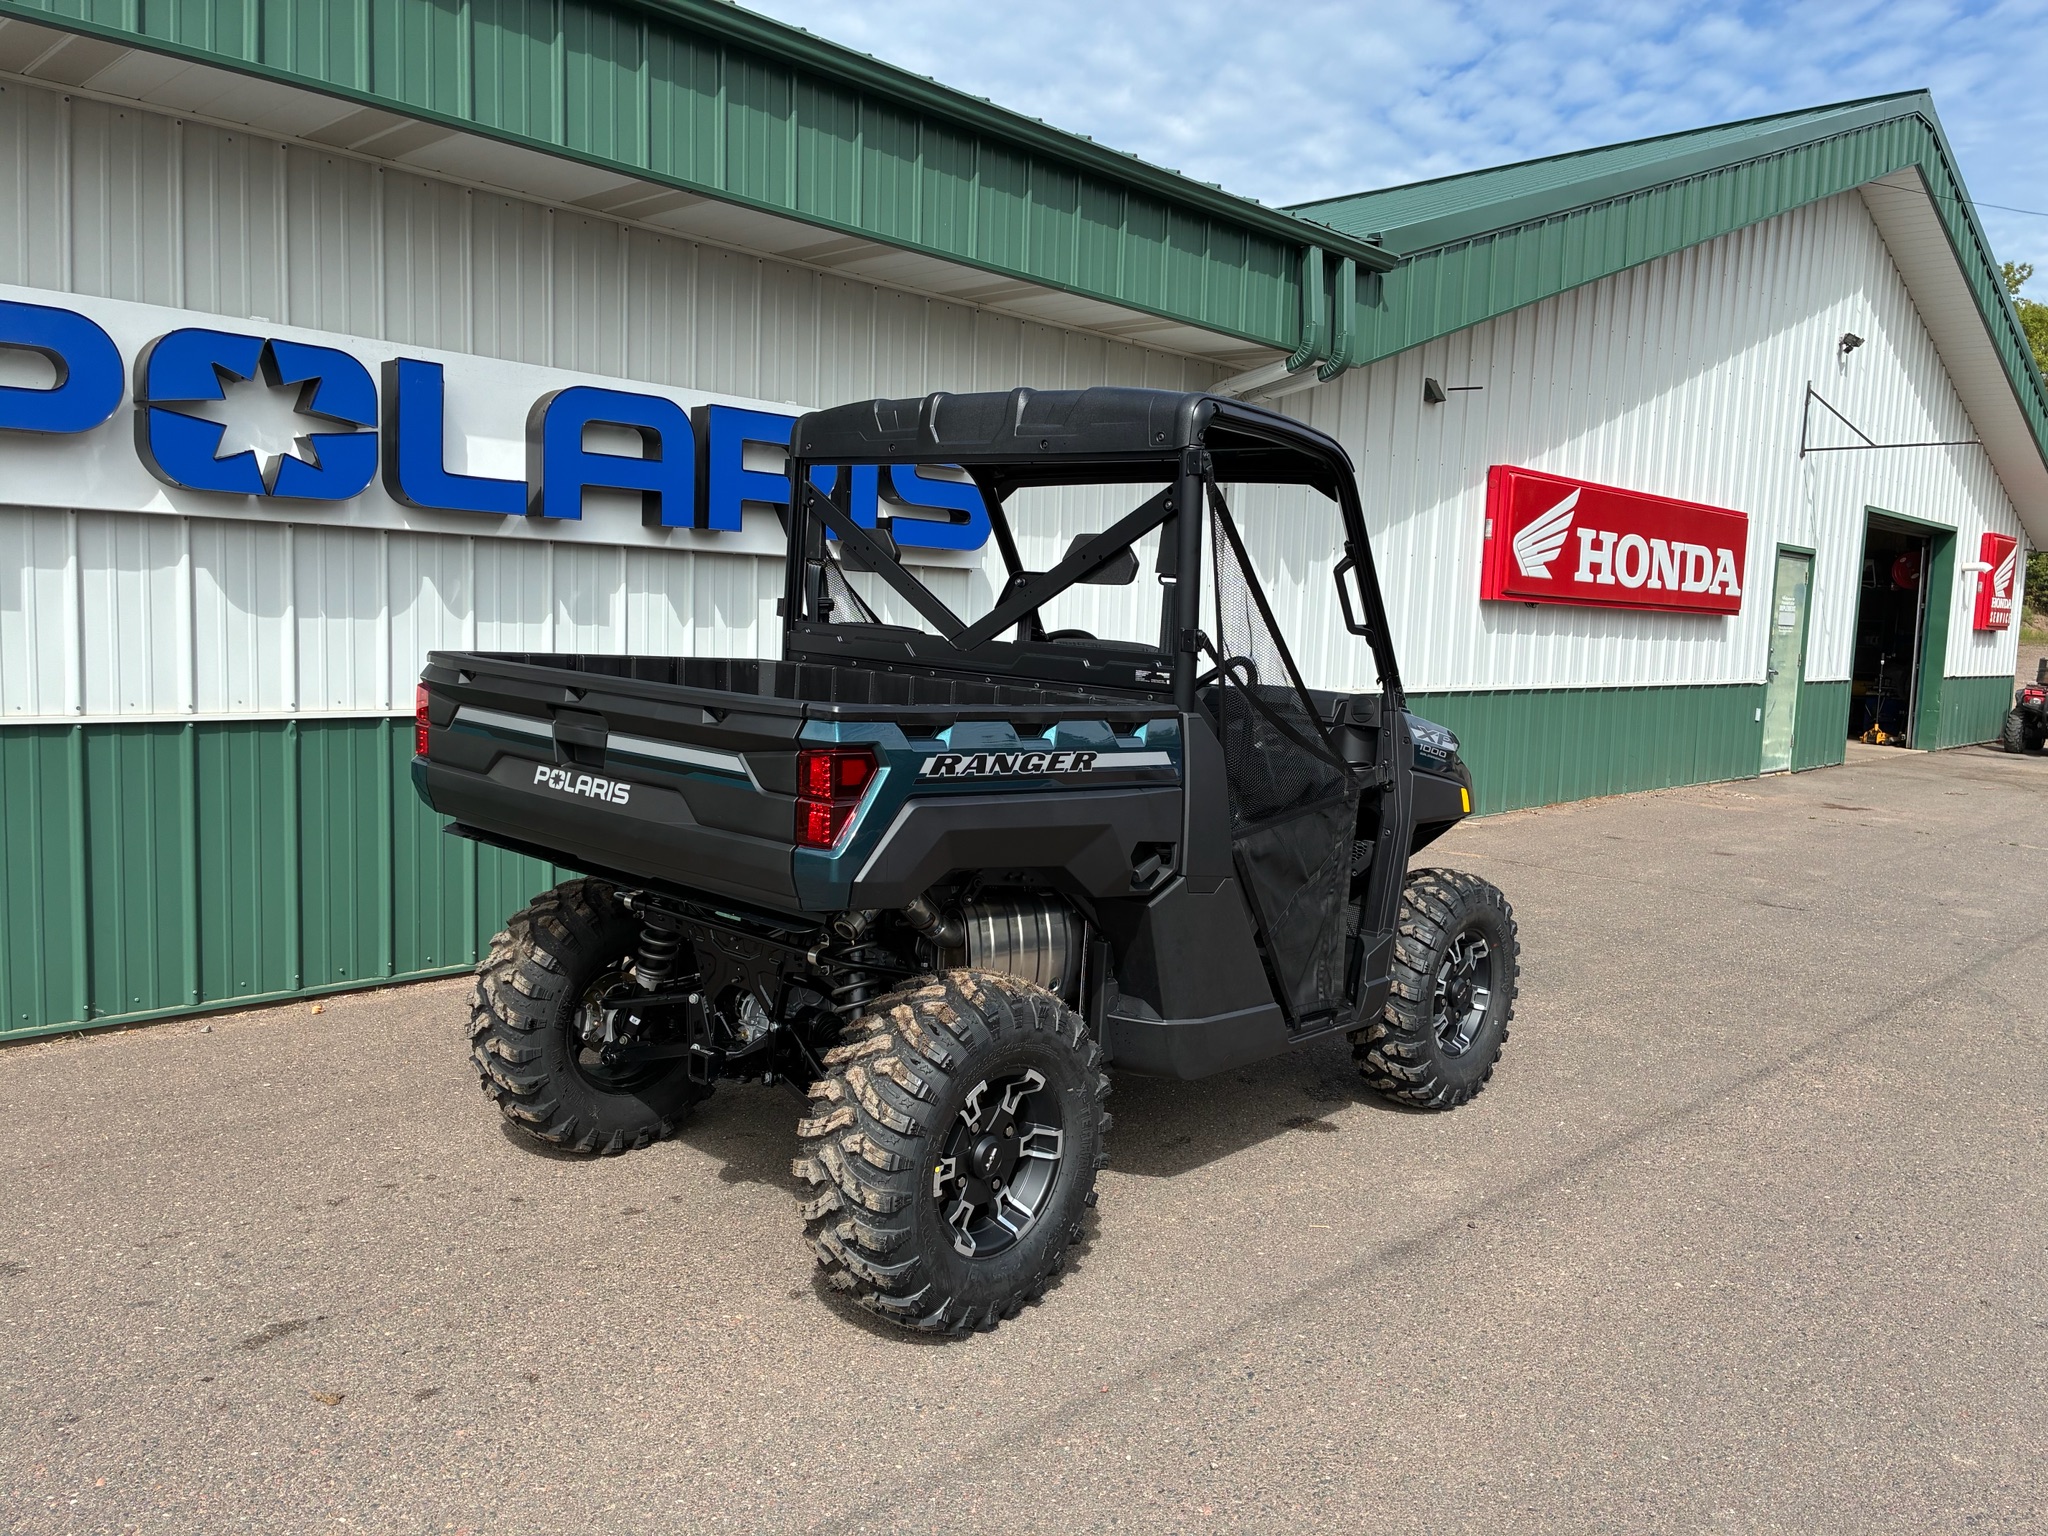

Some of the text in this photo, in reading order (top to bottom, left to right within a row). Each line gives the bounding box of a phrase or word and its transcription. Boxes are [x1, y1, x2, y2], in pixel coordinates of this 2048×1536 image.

[1574, 527, 1741, 597] HONDA
[925, 750, 1098, 777] RANGER
[1420, 743, 1447, 758] 1000
[533, 765, 631, 805] POLARIS
